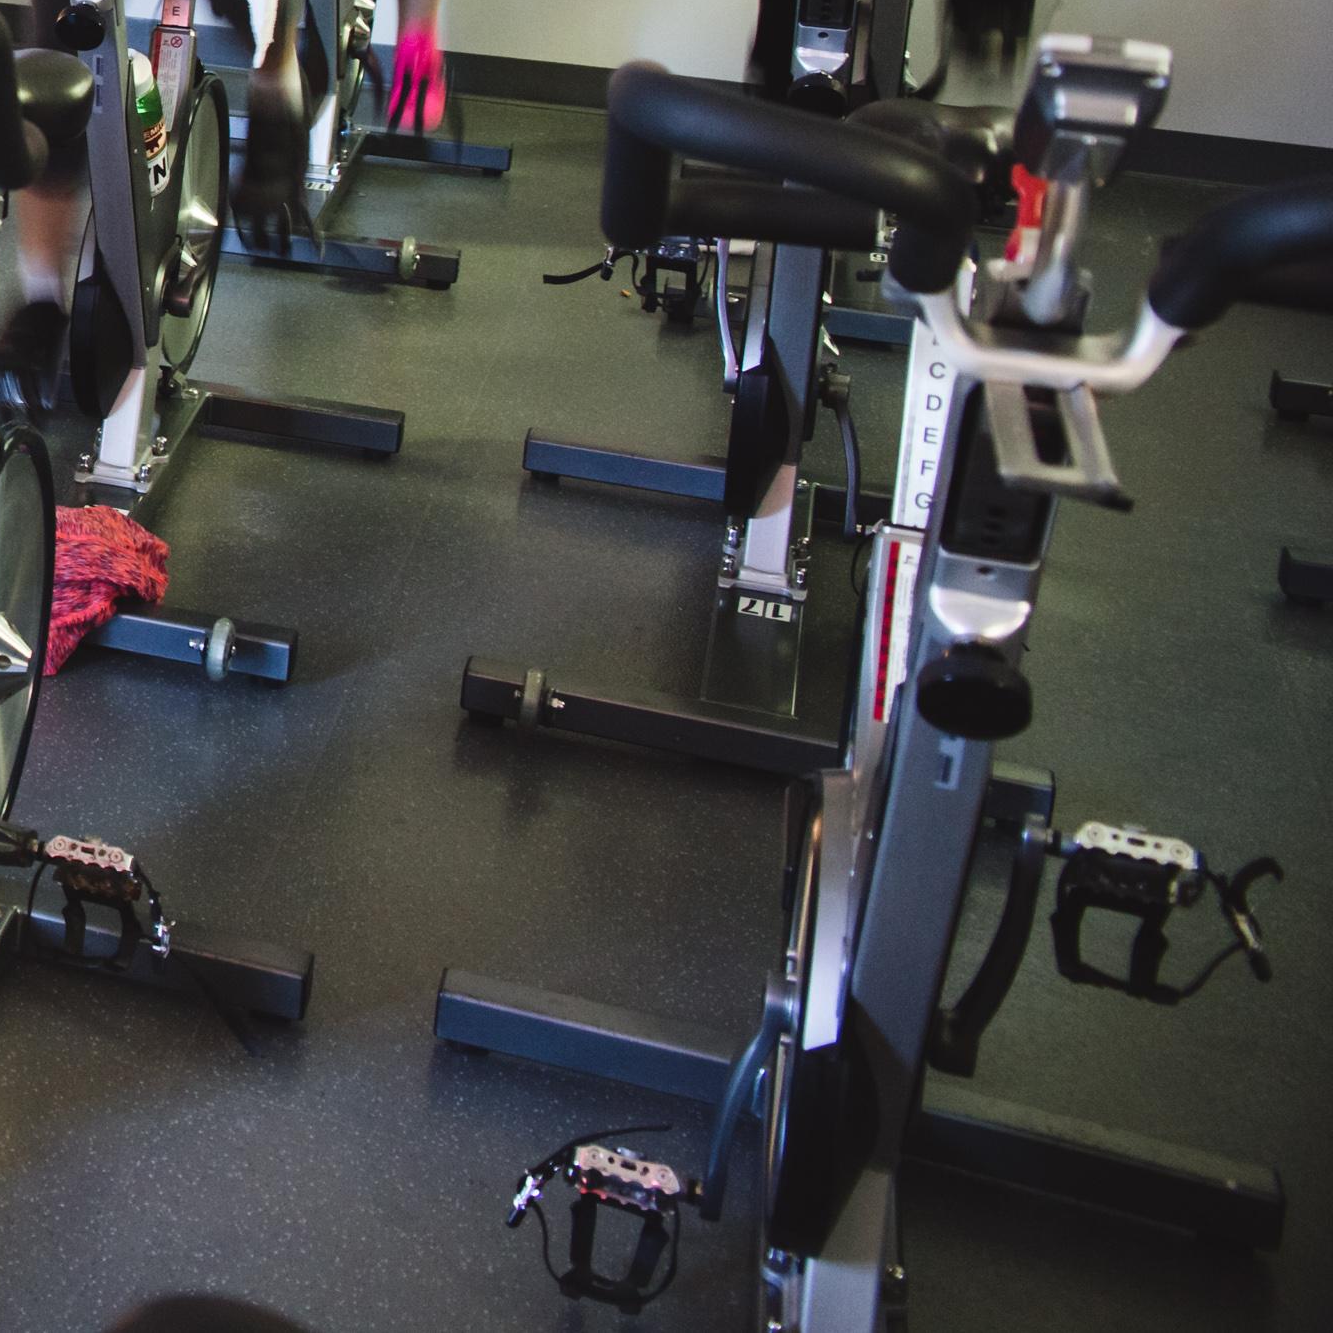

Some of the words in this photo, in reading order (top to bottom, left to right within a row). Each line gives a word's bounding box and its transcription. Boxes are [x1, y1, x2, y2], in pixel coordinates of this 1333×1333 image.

[926, 394, 942, 411] D
[924, 427, 938, 444] E
[741, 599, 784, 618] 17
